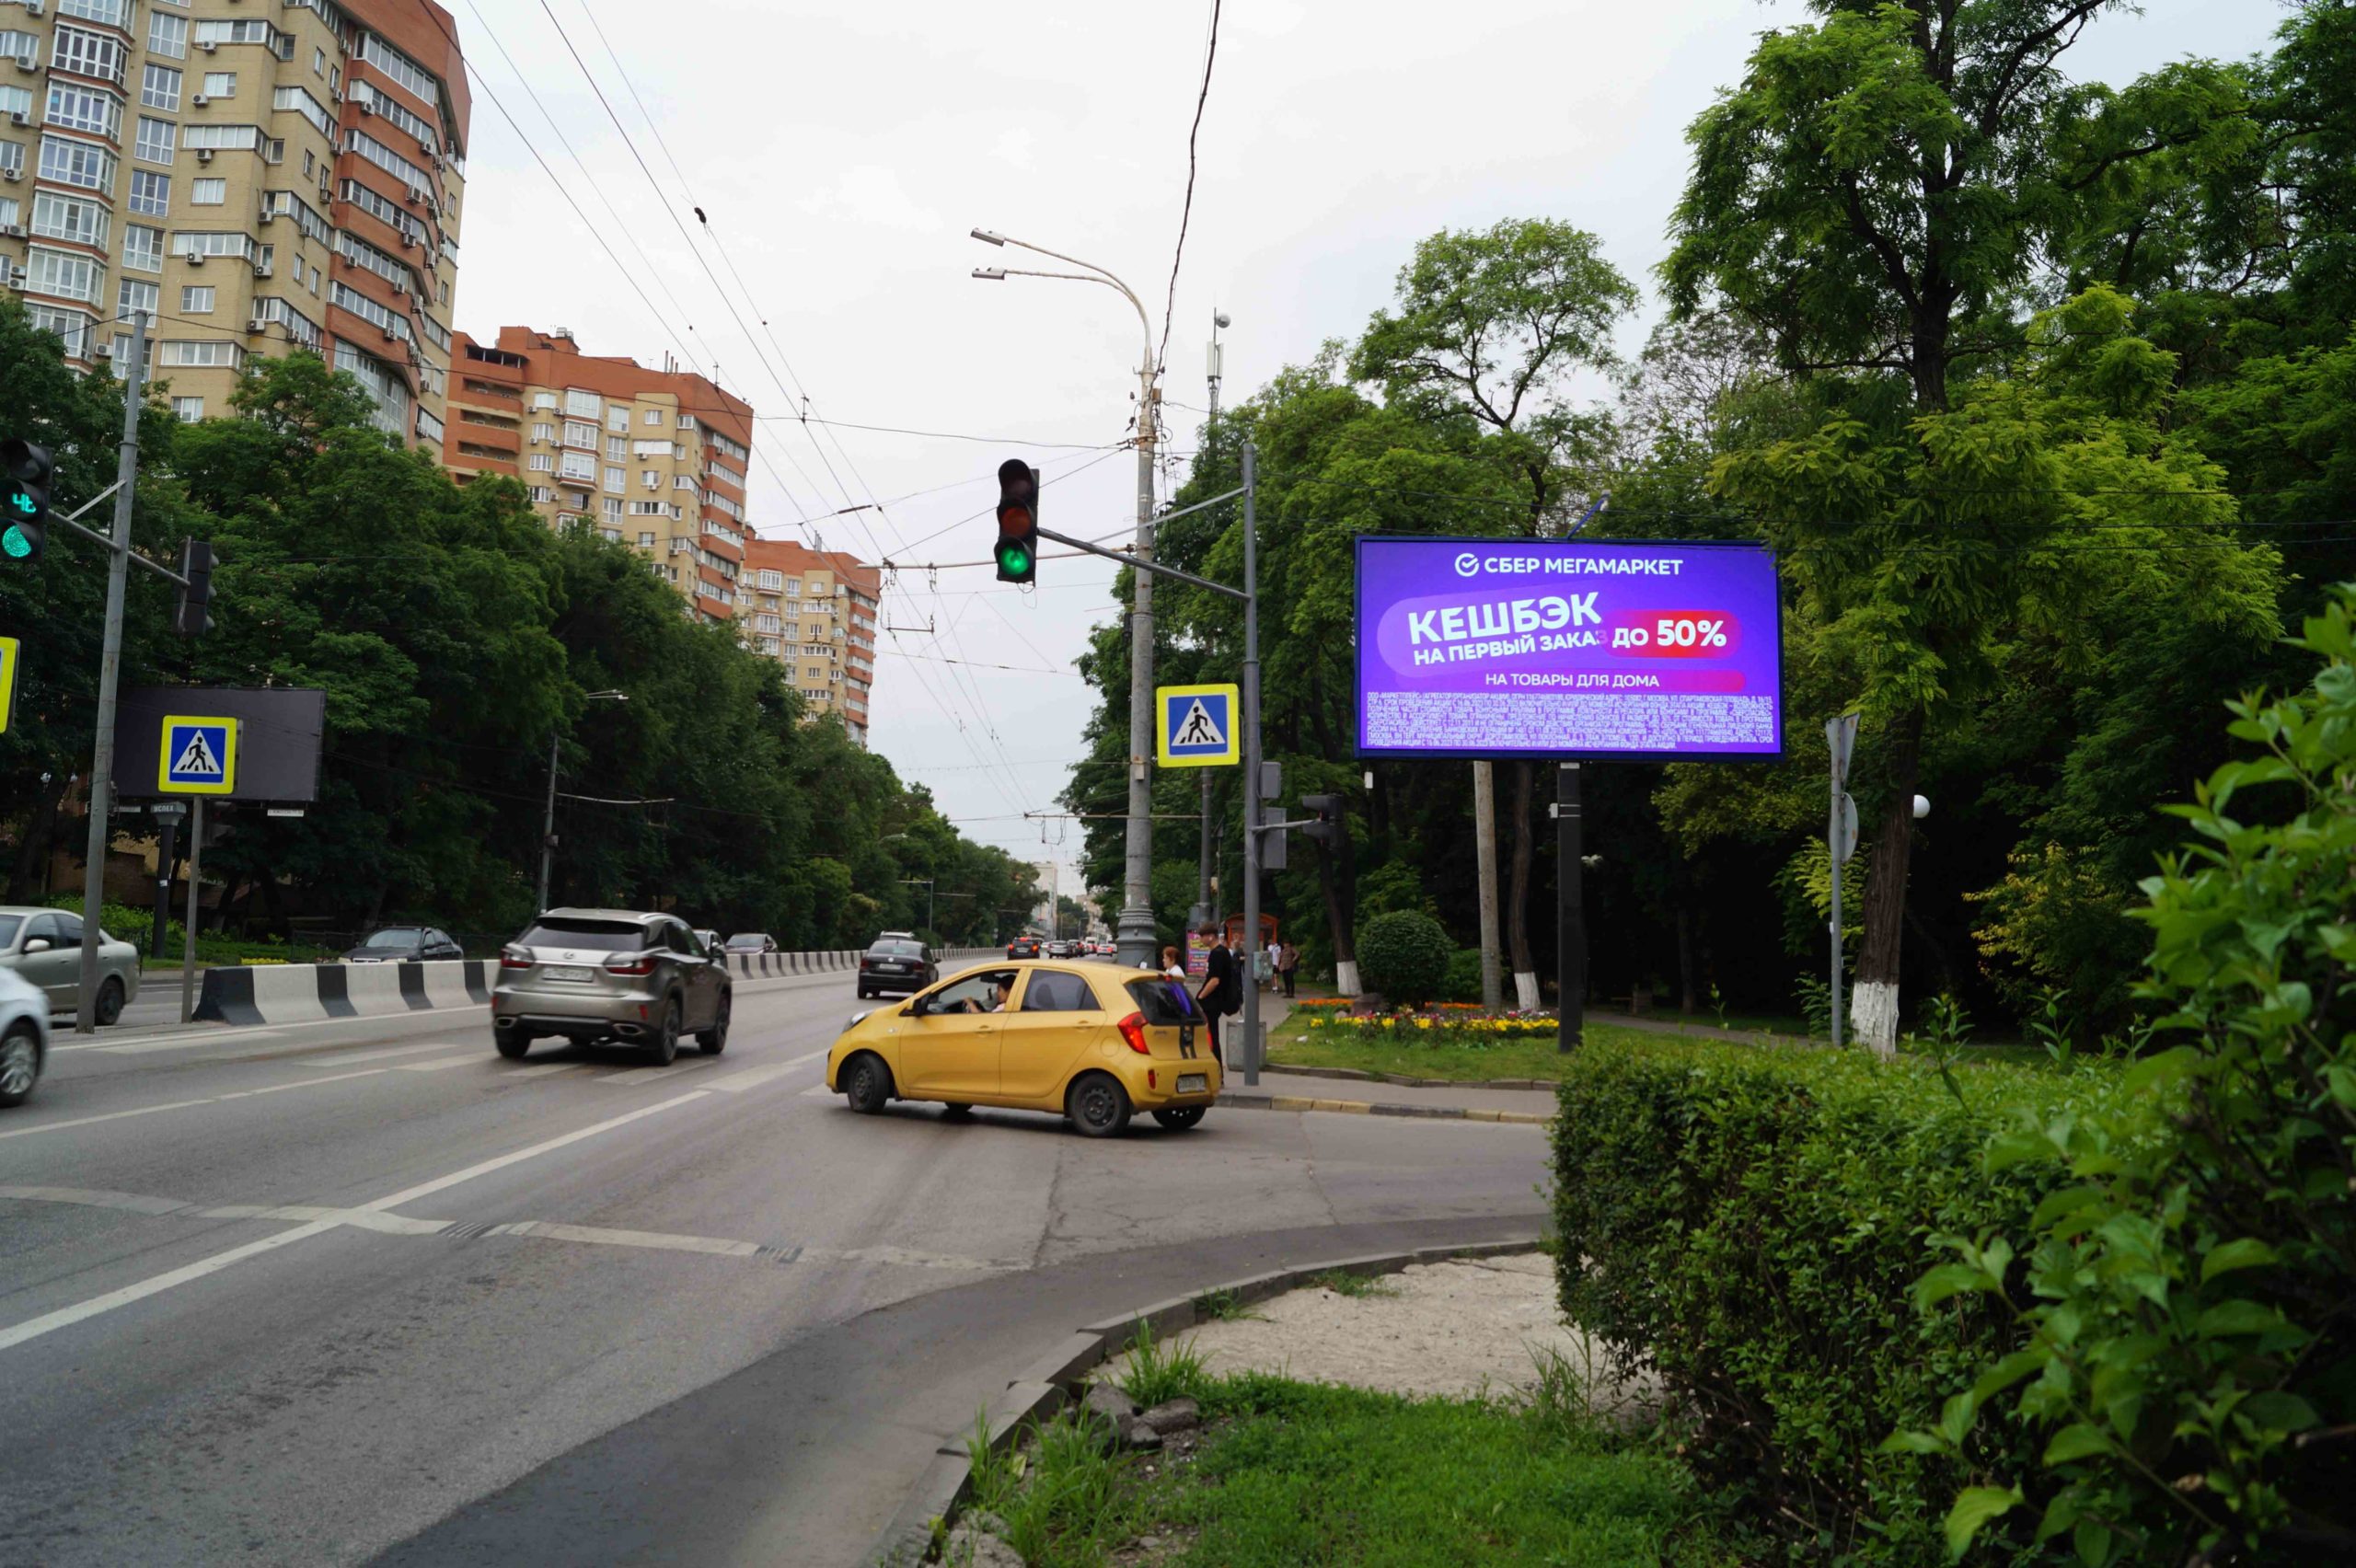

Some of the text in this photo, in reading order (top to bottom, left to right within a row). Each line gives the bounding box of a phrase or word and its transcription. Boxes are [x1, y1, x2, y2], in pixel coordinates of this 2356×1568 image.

[1484, 557, 1683, 575] СБЕР МЕГАМАРКЕТ
[1408, 592, 1602, 645] КЕШБЭК
[1657, 619, 1727, 647] 50%
[1414, 647, 1446, 665] НА
[1449, 633, 1536, 663] ПЕРВЫЙ
[1486, 673, 1660, 688] НА ТОВАРЫ ДЛЯ ДОМА
